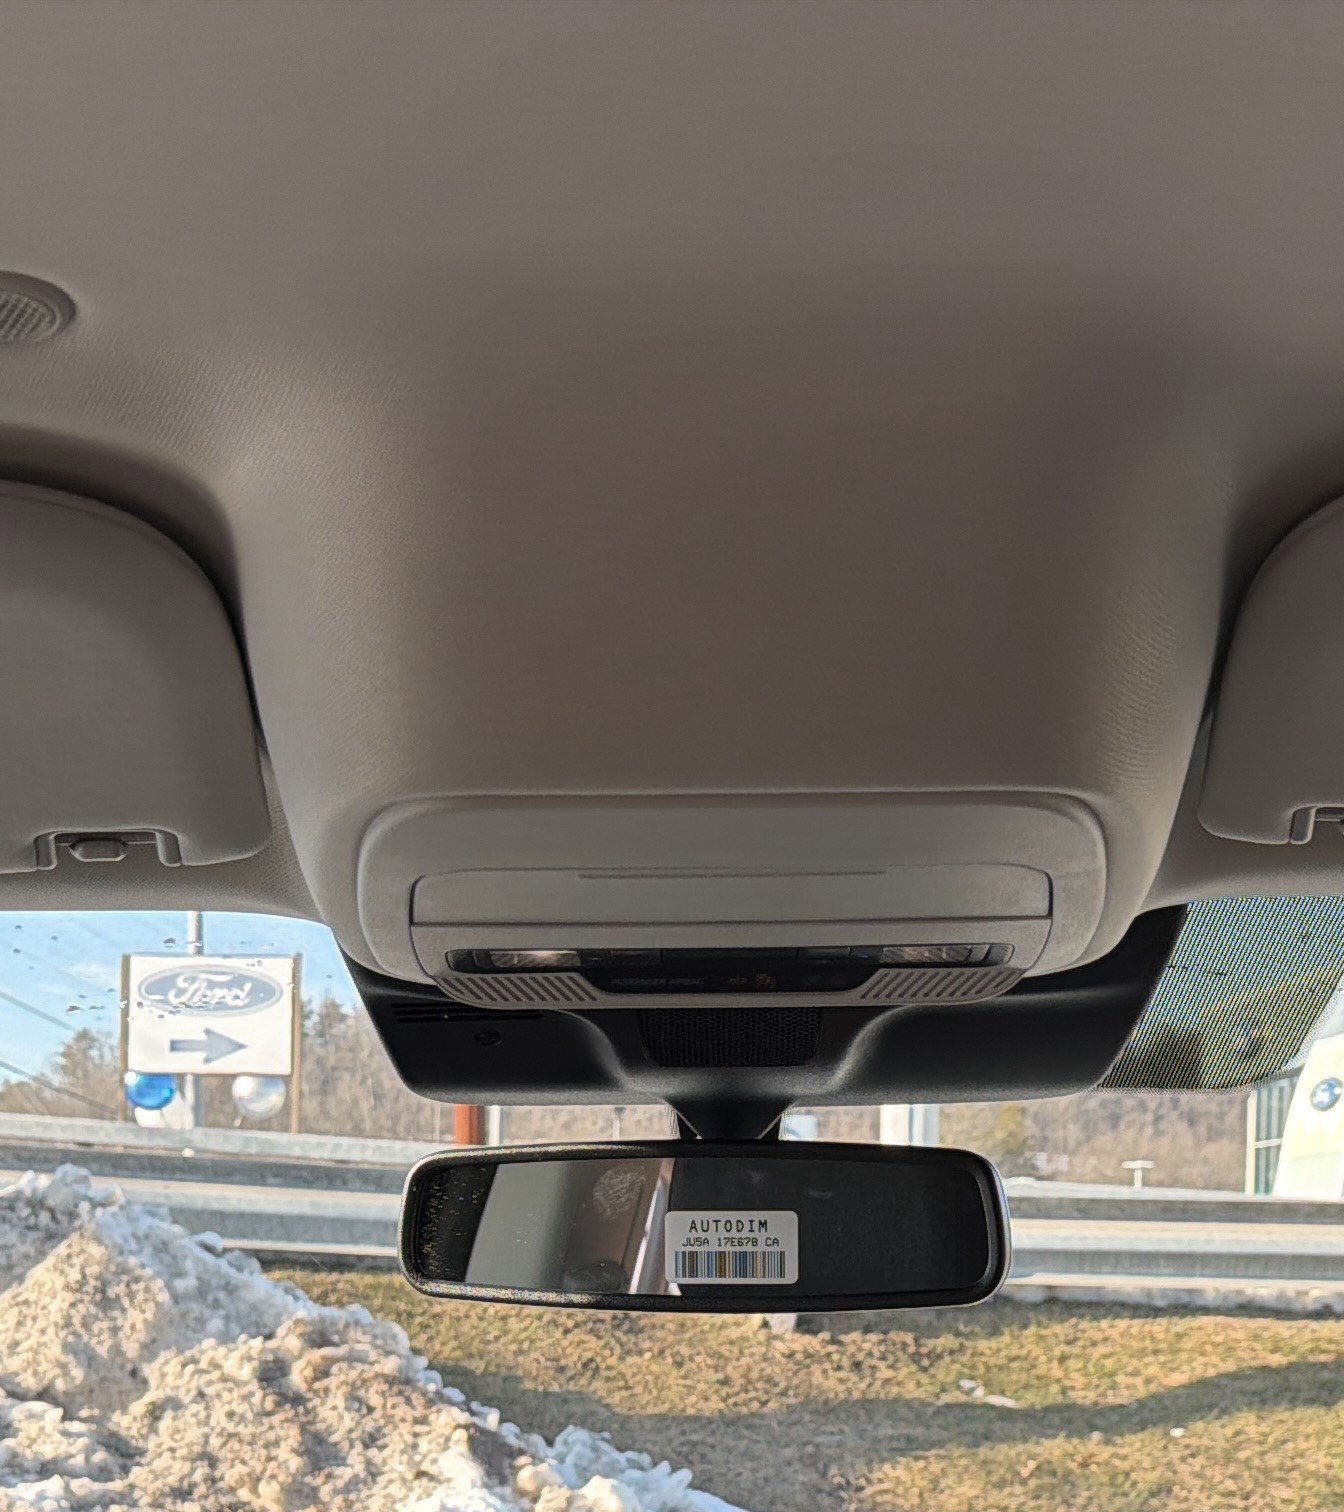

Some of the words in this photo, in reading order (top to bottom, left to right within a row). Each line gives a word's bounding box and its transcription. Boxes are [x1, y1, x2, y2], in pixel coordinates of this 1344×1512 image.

[168, 973, 253, 1007] Ford
[688, 1219, 769, 1233] AUTODIM
[681, 1236, 710, 1247] JU5A
[764, 1236, 780, 1247] CA
